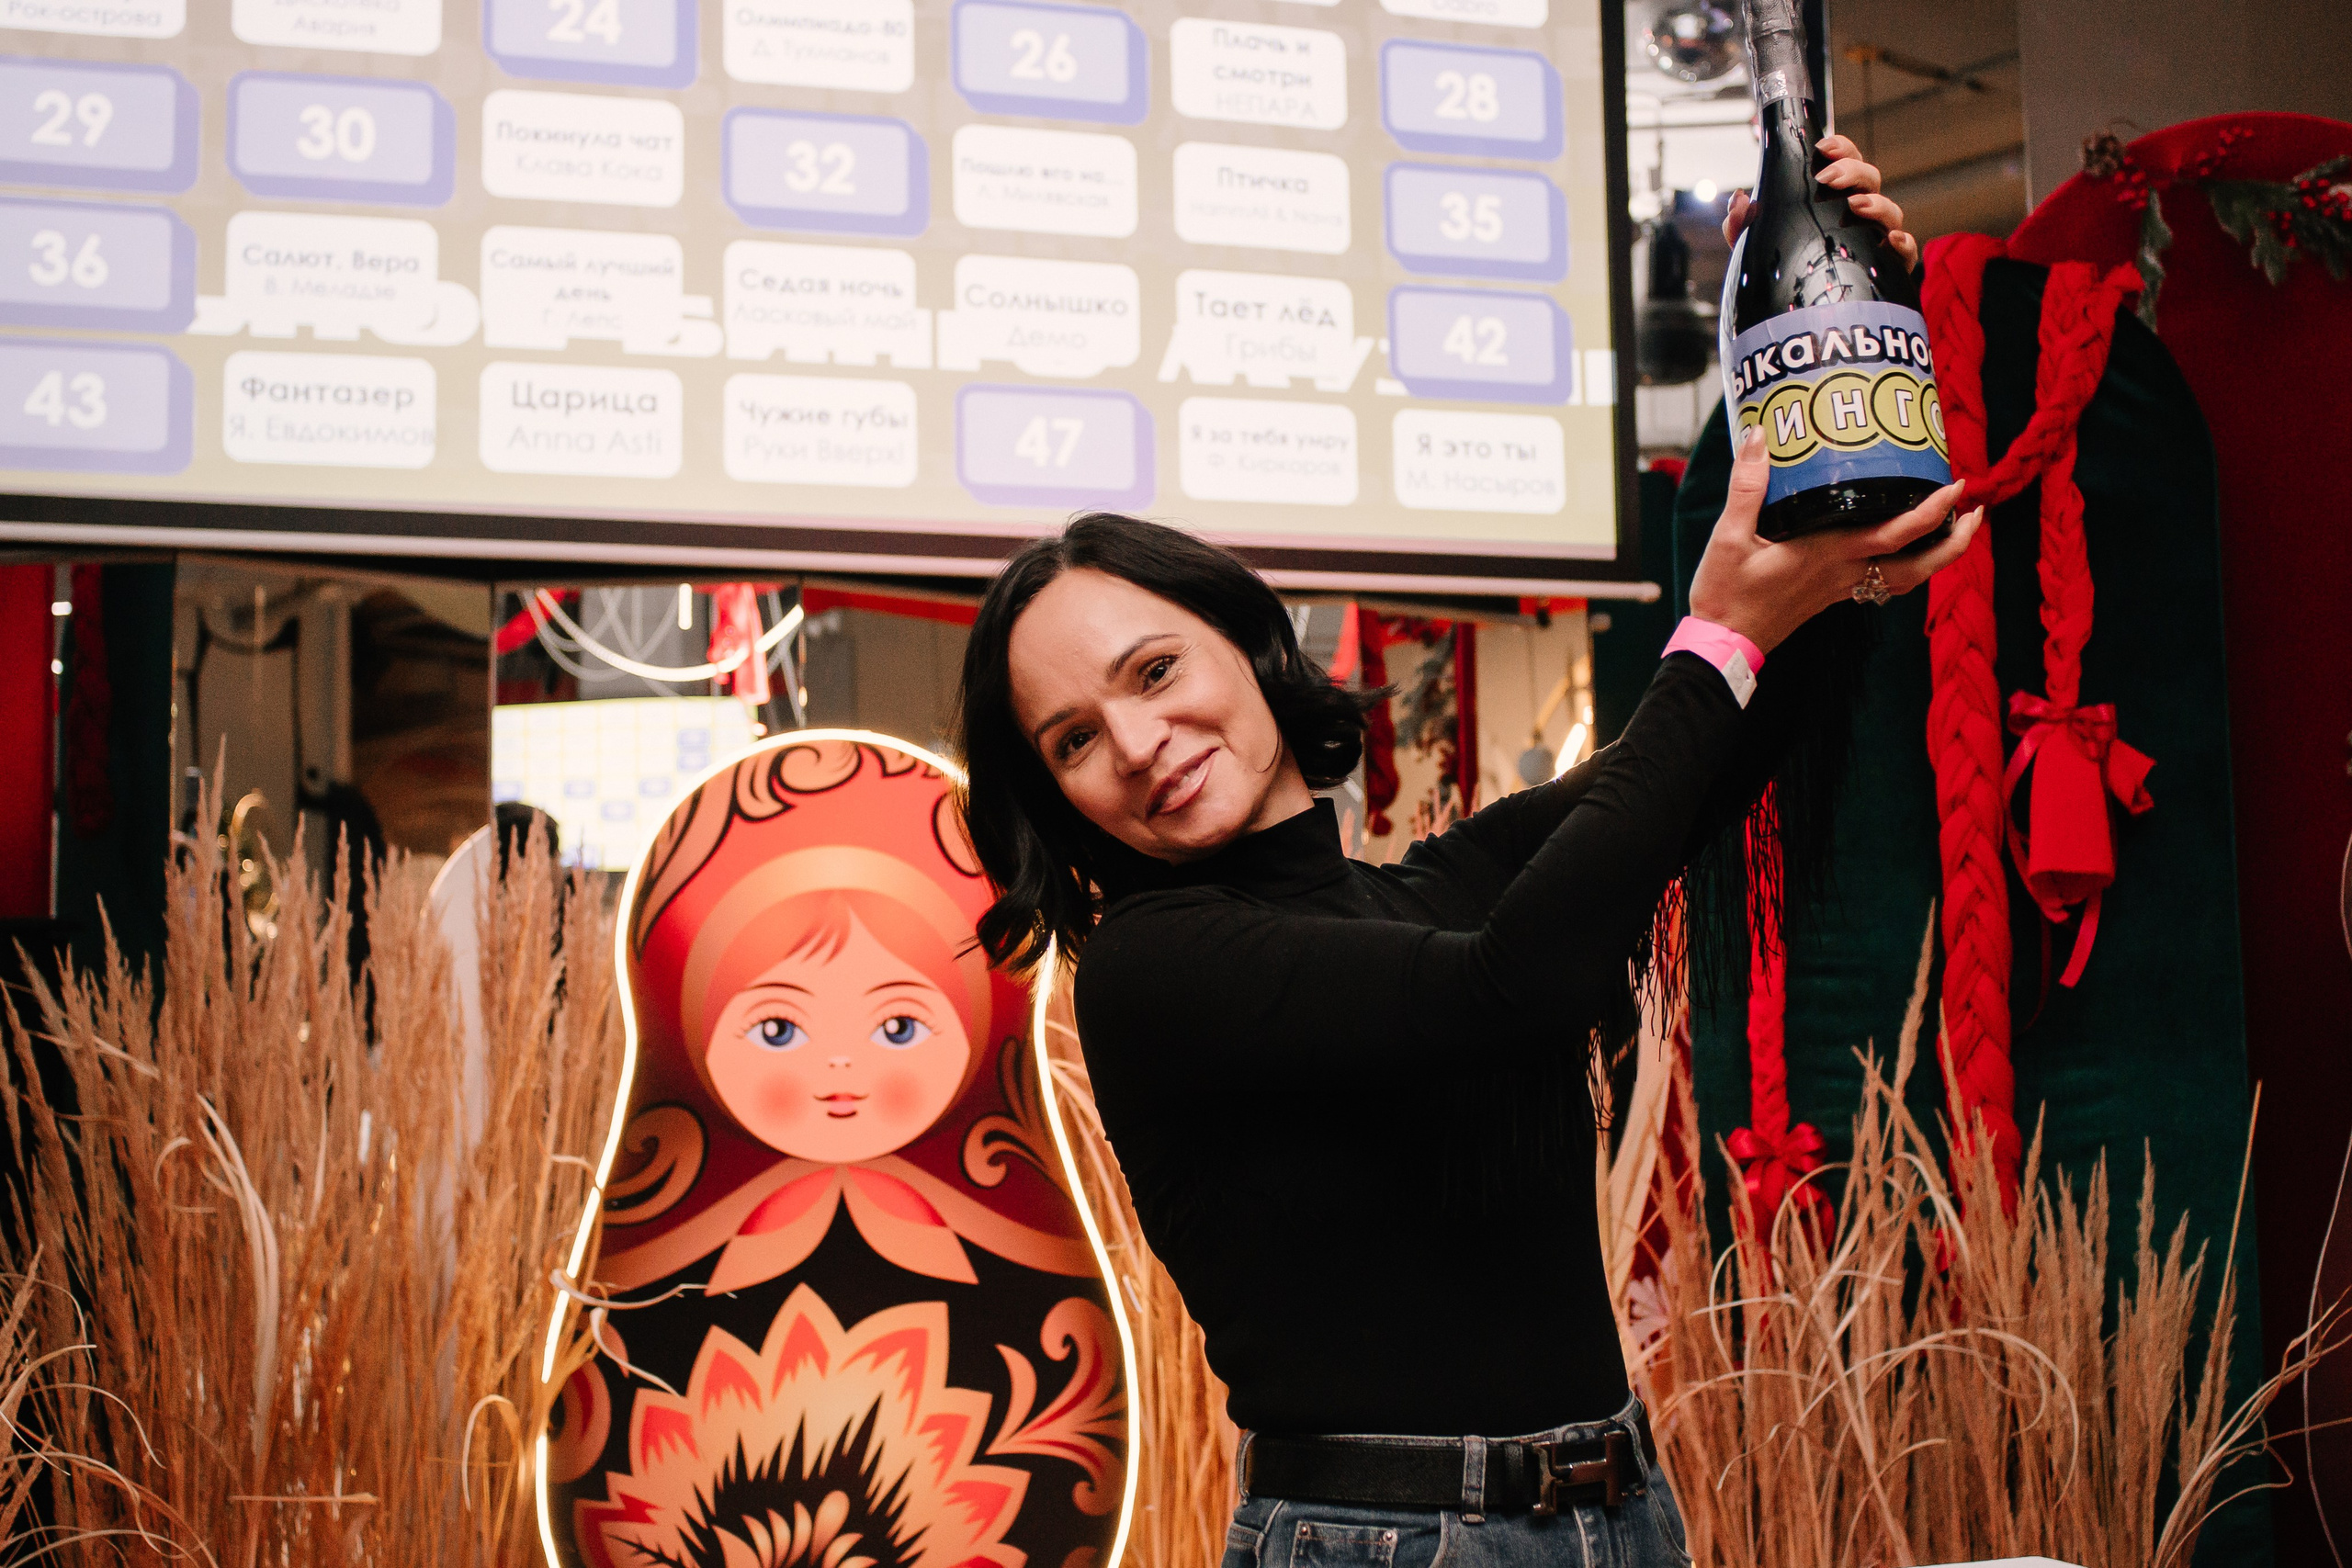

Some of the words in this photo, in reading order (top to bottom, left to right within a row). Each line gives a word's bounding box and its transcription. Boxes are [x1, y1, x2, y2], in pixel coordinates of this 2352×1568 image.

[547, 0, 623, 44] 24
[1011, 28, 1078, 83] 26
[1213, 65, 1312, 89] смотри
[1215, 92, 1316, 121] НЕПАРА
[1434, 69, 1500, 121] 28
[30, 89, 115, 148] 29
[296, 104, 377, 163] 30
[496, 120, 621, 149] Покинула
[629, 133, 674, 150] чат
[515, 153, 593, 178] Клава
[600, 161, 663, 182] Кока
[784, 140, 856, 196] 32
[1216, 166, 1309, 195] Птичка
[1439, 191, 1504, 243] 35
[28, 229, 109, 288] 36
[242, 243, 342, 272] Салют,
[351, 249, 420, 276] Вера
[490, 249, 577, 271] Самый
[553, 285, 613, 304] день
[739, 267, 829, 299] Седая
[840, 277, 904, 299] ночь
[965, 283, 1129, 318] Солнышко
[1193, 291, 1266, 321] Тает
[1277, 296, 1338, 327] лёд
[1006, 325, 1087, 351] Демо
[1224, 333, 1317, 361] Грибы
[1443, 315, 1509, 367] 42
[23, 369, 107, 430] 43
[240, 375, 416, 412] Фантазер
[512, 381, 658, 417] Царица
[229, 415, 254, 441] Я.
[739, 400, 830, 428] Чужие
[842, 405, 909, 430] губы
[1740, 386, 1947, 446] ИНГО
[506, 425, 595, 453] Anna
[607, 430, 662, 457] Asti
[743, 437, 808, 464] Руки
[1014, 415, 1085, 468] 47
[1191, 424, 1202, 442] Я
[1211, 427, 1232, 443] за
[1240, 429, 1288, 448] тебя
[1295, 434, 1349, 452] умру
[1417, 434, 1431, 455] Я
[1442, 438, 1492, 459] это
[1502, 441, 1536, 460] ты
[1444, 471, 1555, 496] Насыров
